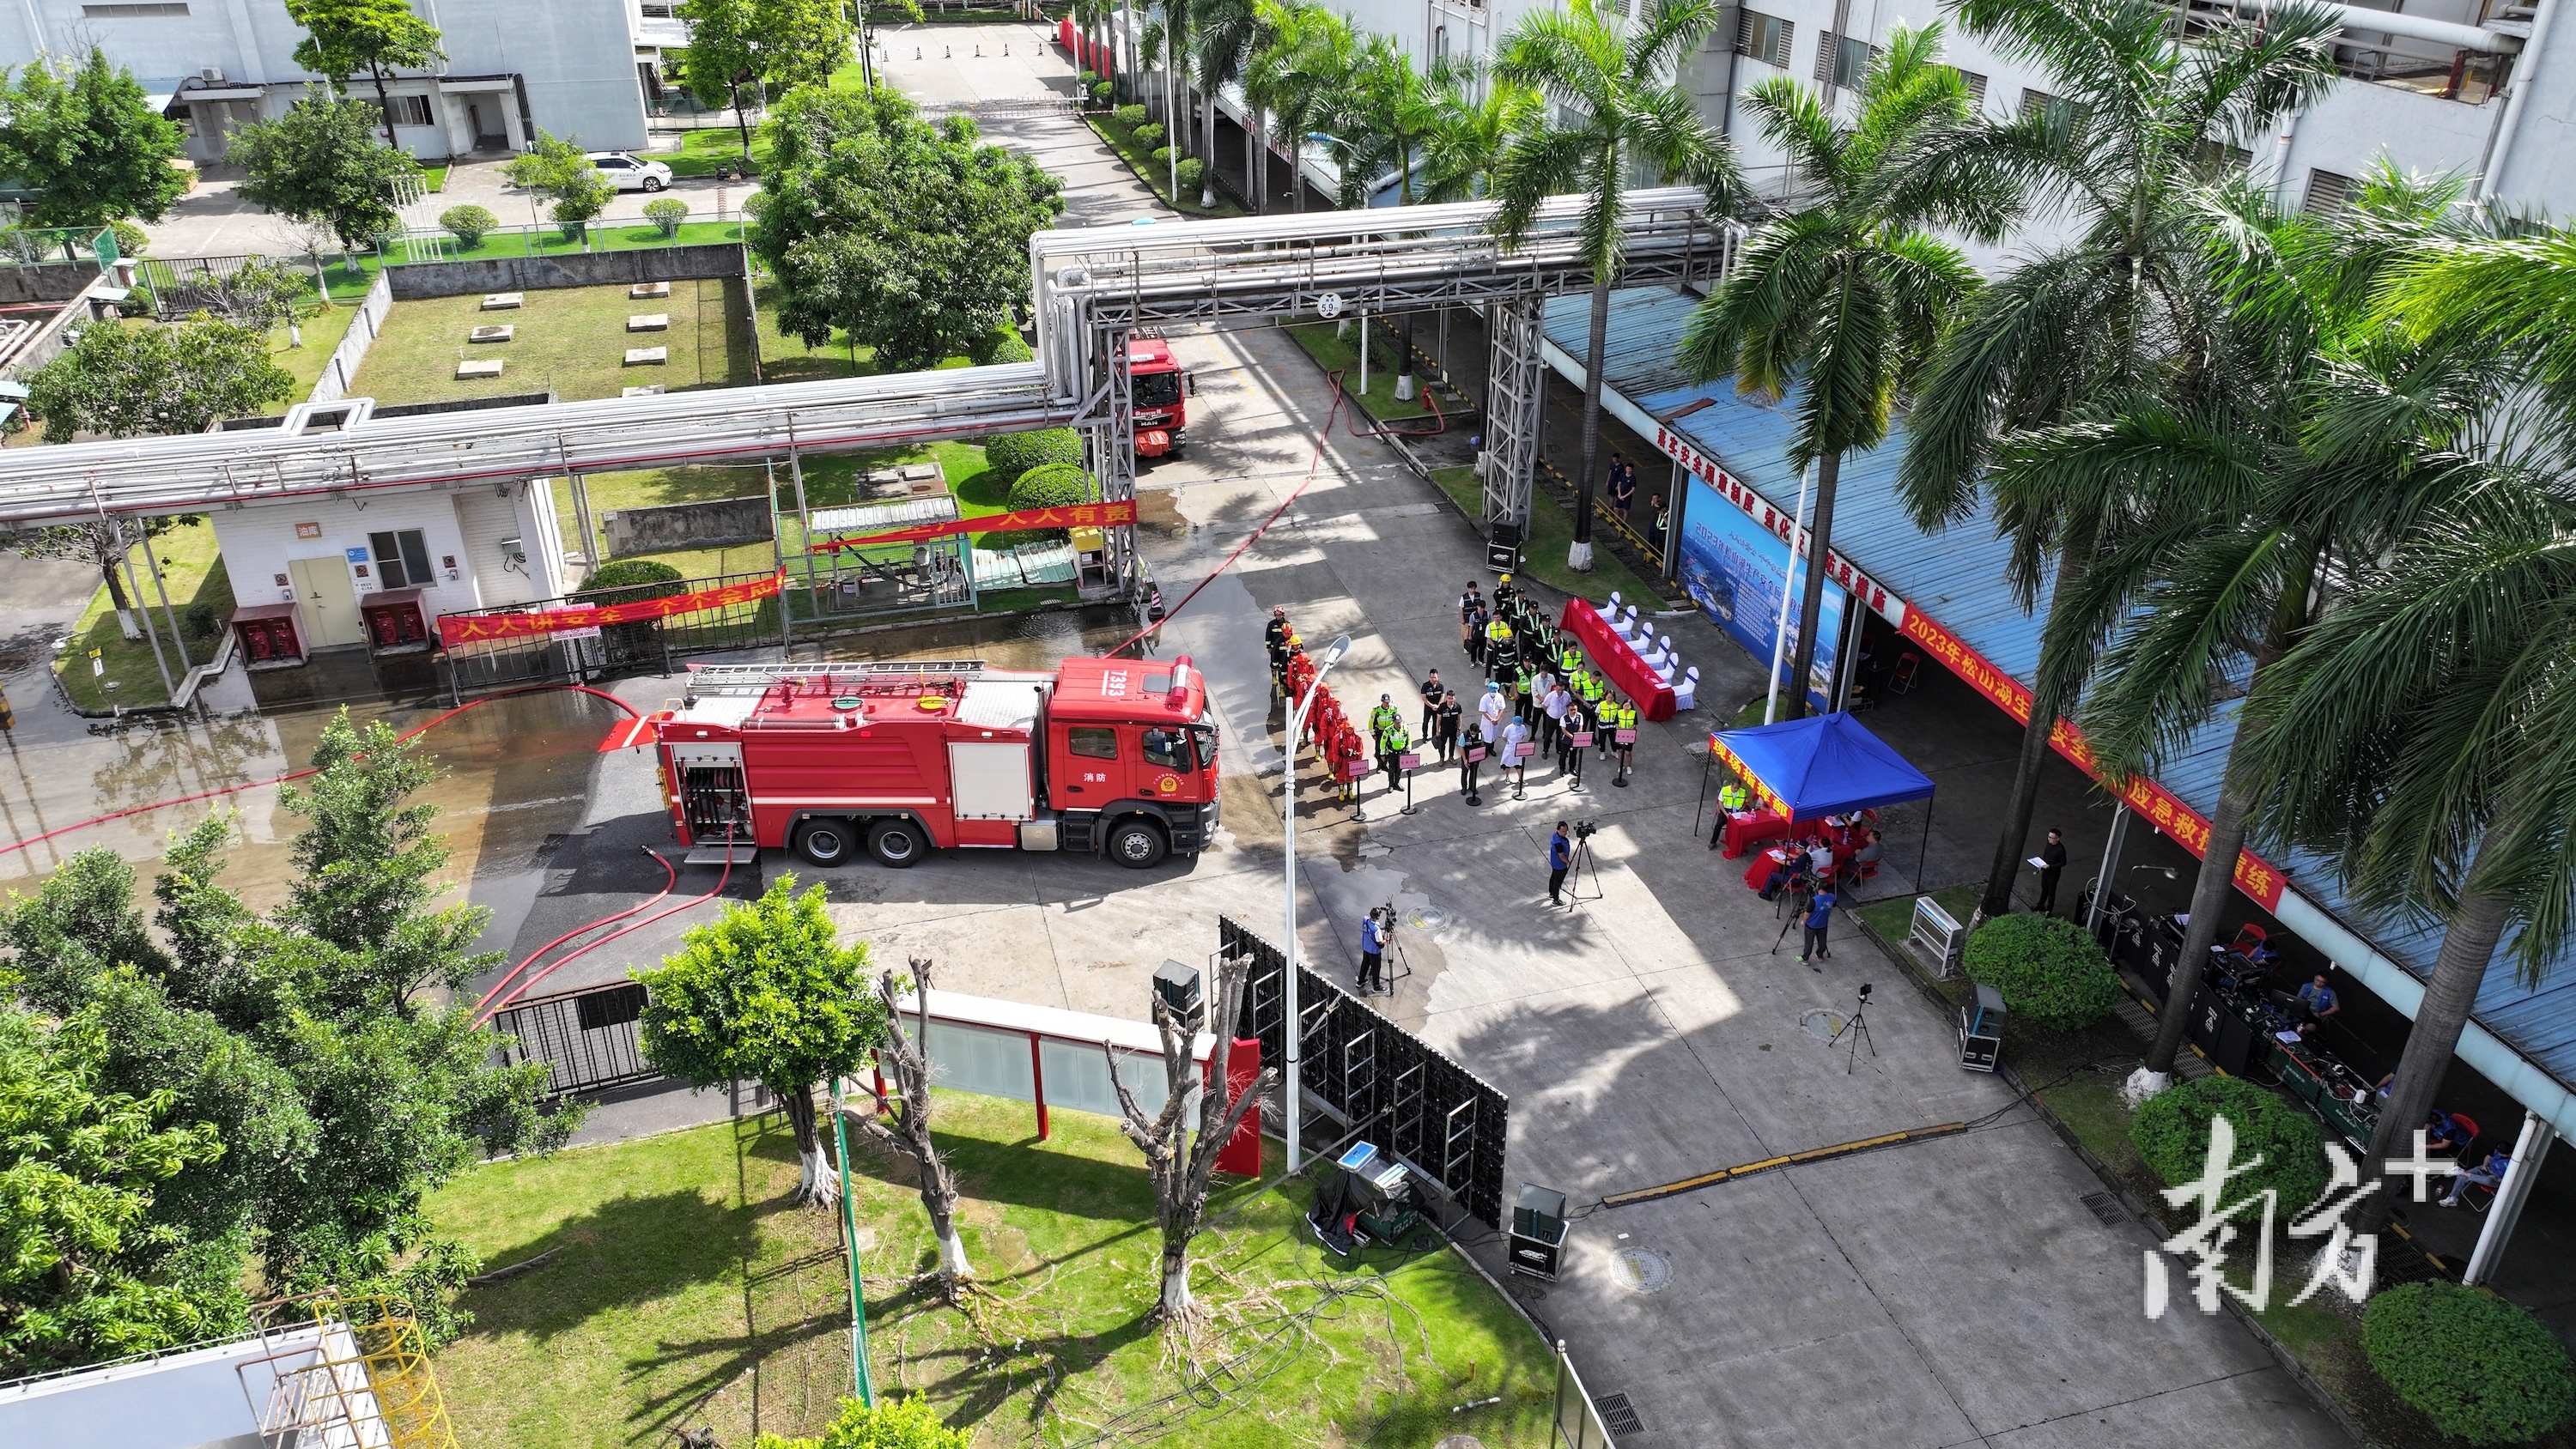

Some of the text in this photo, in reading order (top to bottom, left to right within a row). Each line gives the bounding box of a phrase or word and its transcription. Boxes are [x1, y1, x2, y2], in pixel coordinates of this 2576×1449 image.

[998, 505, 1133, 526] 人人有责
[1656, 427, 1755, 515] 落实安全规章制度
[1764, 506, 1886, 614] 强化安防范措施
[298, 525, 319, 537] 油库
[460, 608, 623, 639] 人人讲安全
[1108, 670, 1127, 696] 7393
[1907, 613, 2273, 899] 2023年松山湖生安全应急救练
[1083, 772, 1107, 783] 消防
[1712, 738, 1789, 818] 现场指挥部
